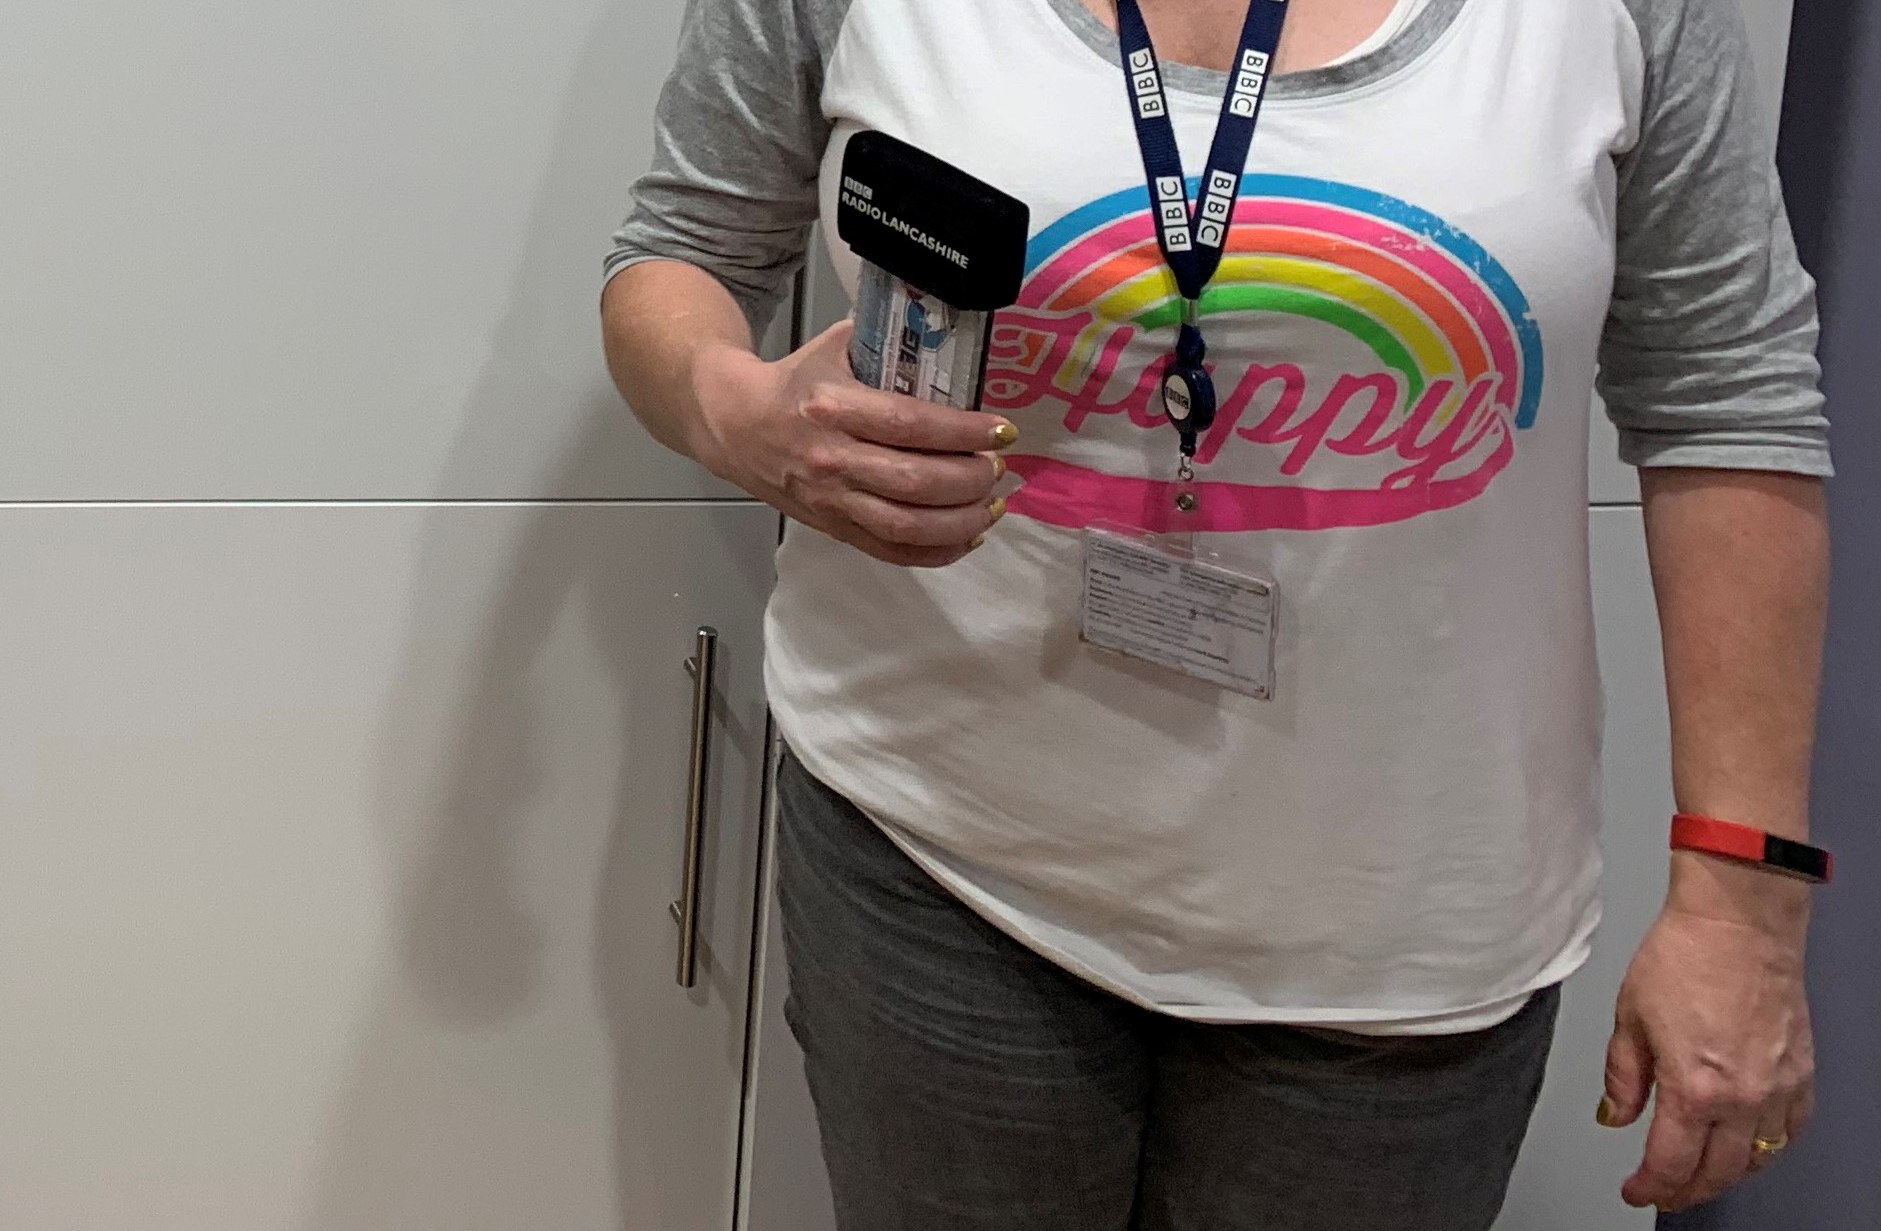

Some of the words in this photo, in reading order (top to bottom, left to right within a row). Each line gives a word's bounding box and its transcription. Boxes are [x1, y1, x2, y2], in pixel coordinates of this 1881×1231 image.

[1129, 46, 1167, 119] BBC
[1229, 48, 1269, 119] BBC
[843, 176, 873, 201] BBC
[1155, 175, 1193, 253] BBC
[1196, 169, 1238, 248] BBC
[841, 191, 881, 220] RADIO
[881, 210, 970, 270] LANCASHIRE
